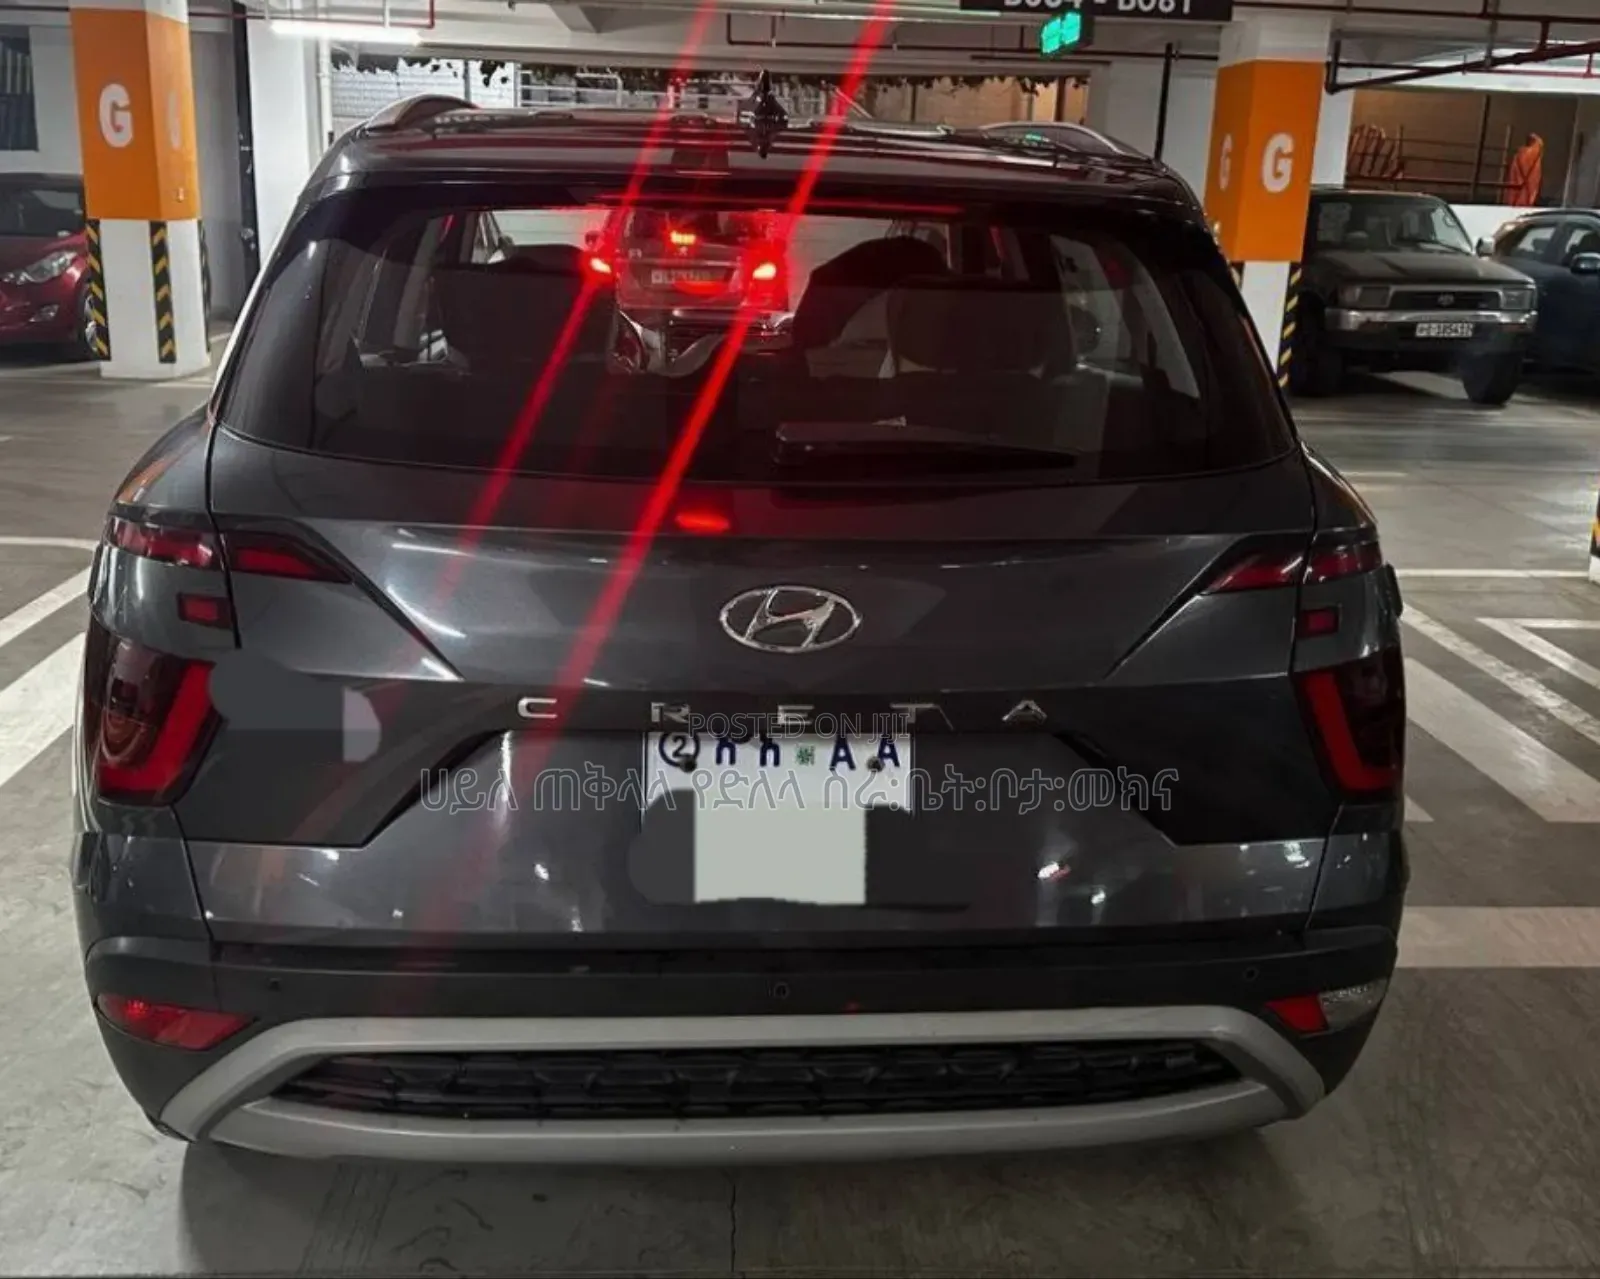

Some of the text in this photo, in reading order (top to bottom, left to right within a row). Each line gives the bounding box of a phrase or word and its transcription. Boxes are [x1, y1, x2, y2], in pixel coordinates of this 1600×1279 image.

[99, 83, 133, 148] G
[1262, 132, 1294, 193] G
[517, 697, 1048, 725] CRETA
